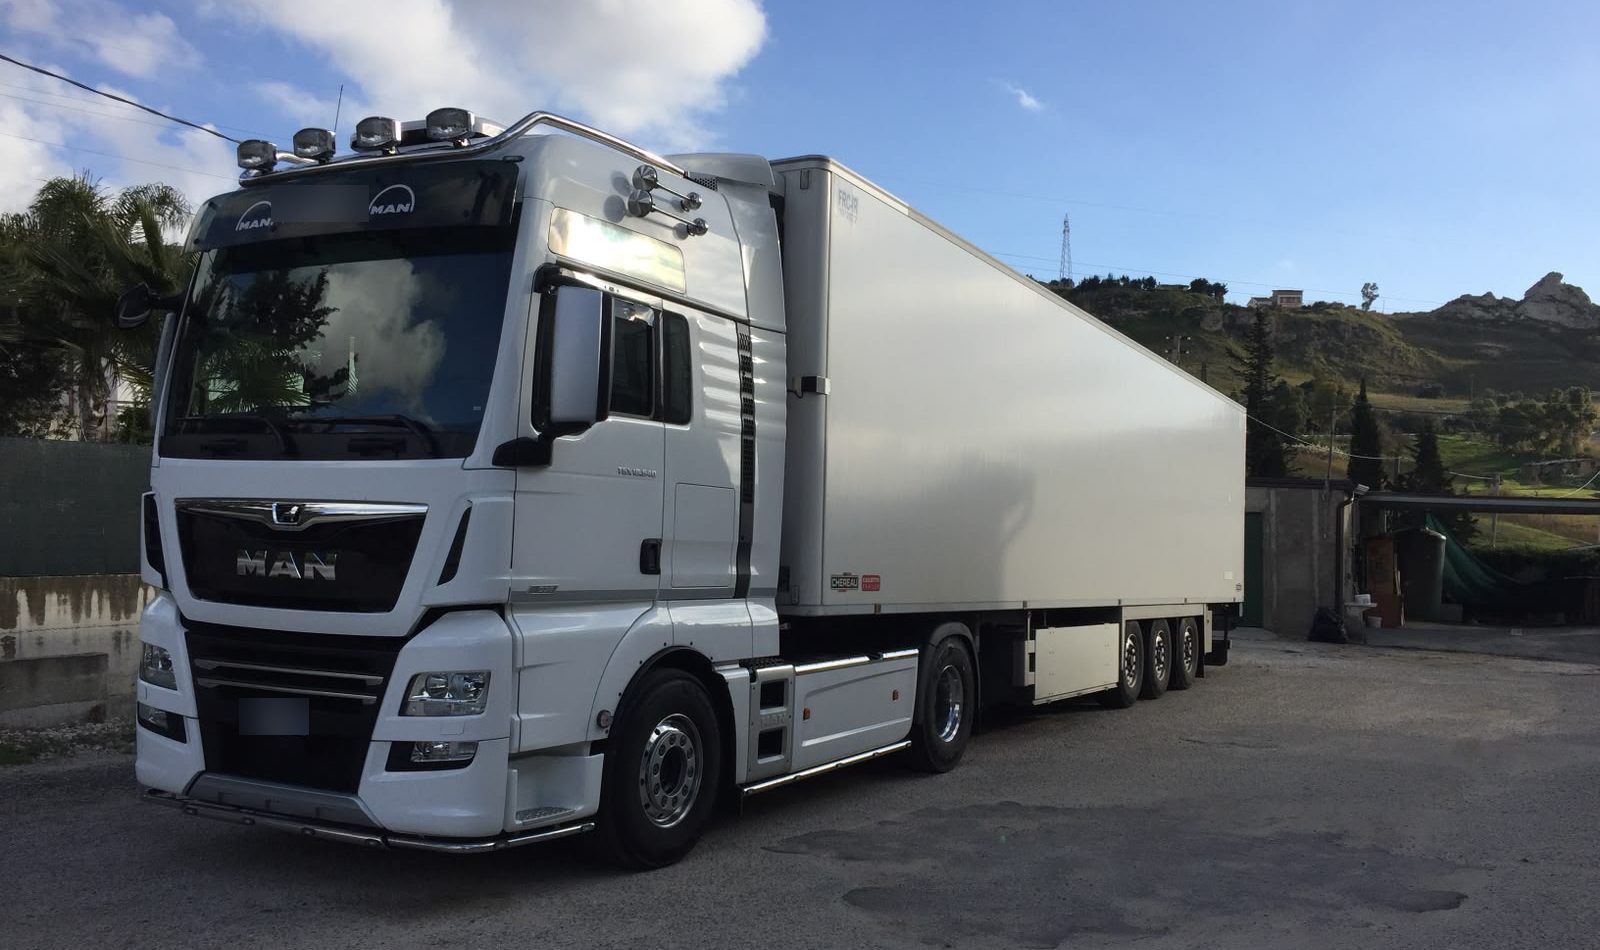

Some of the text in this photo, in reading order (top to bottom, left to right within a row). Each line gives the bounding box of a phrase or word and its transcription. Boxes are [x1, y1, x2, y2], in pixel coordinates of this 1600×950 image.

[370, 203, 411, 215] MAN
[239, 217, 272, 231] MAN
[236, 550, 337, 580] MAN
[831, 577, 859, 588] CHEREAU
